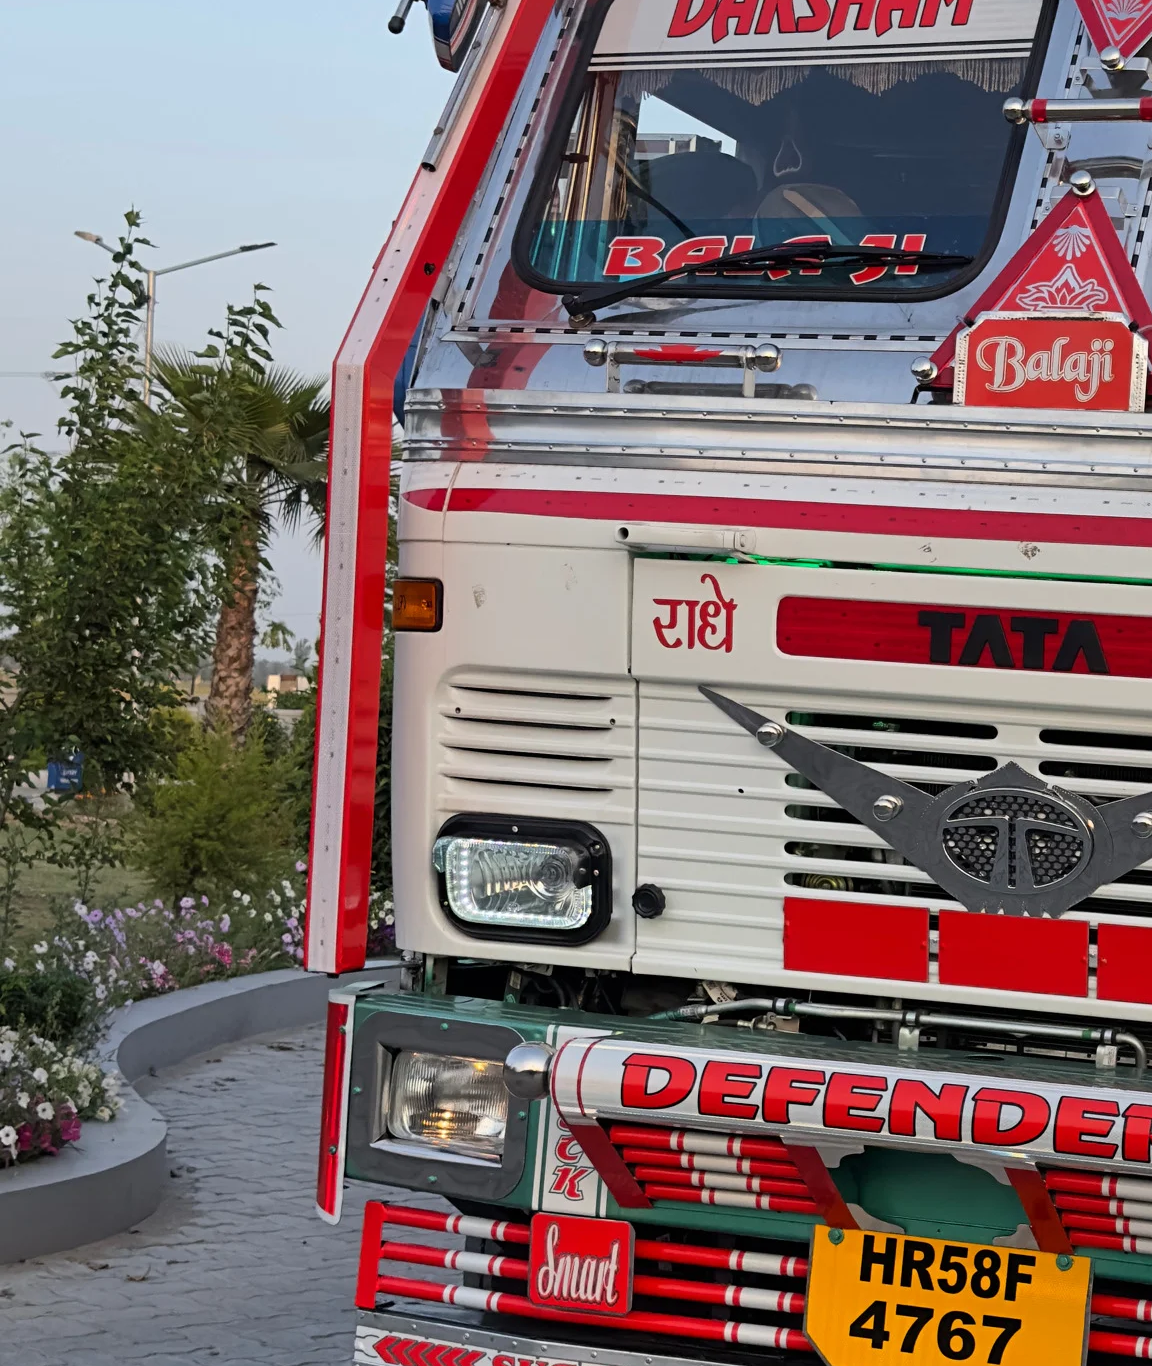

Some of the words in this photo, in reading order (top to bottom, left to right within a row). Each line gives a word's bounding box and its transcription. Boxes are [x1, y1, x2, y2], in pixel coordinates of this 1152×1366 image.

[976, 335, 1115, 402] Balaji
[652, 573, 738, 654] राधे
[917, 609, 1111, 674] TATA
[536, 1222, 620, 1305] Smart
[859, 1234, 1037, 1302] HR58F
[848, 1300, 1023, 1366] 4767
